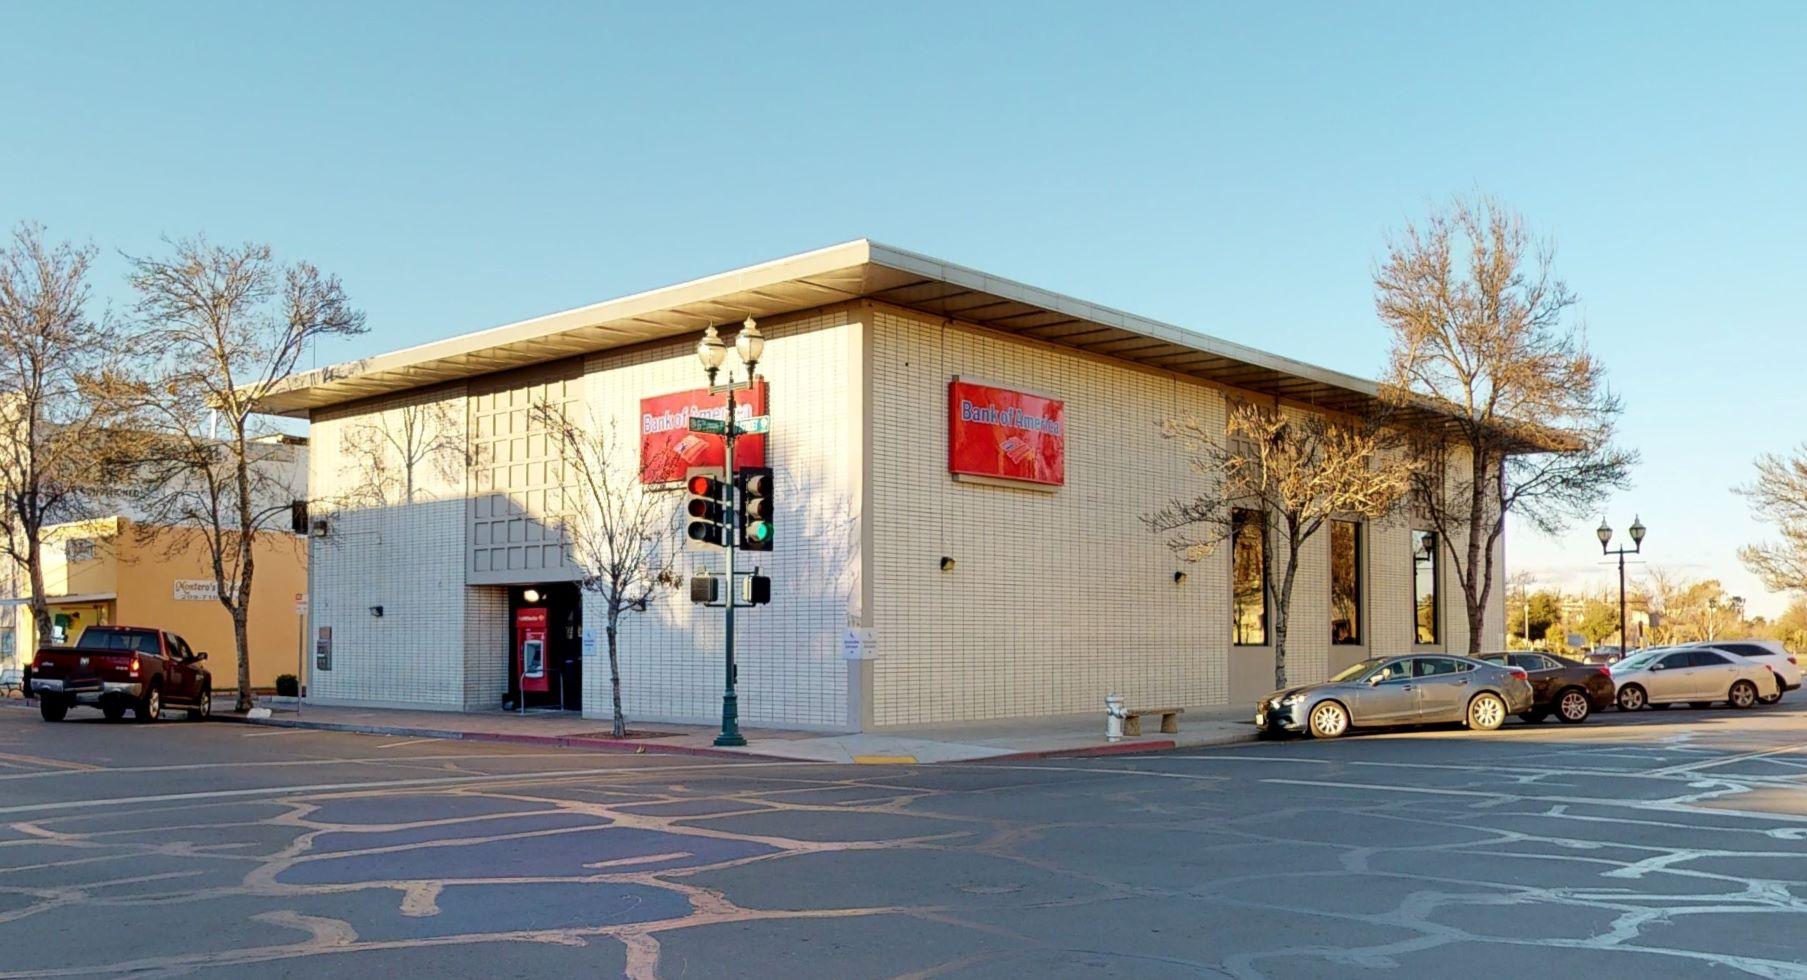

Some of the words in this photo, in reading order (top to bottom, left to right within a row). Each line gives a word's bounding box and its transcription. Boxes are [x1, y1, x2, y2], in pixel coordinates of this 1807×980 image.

[643, 409, 673, 434] Bank
[674, 405, 690, 428] of
[690, 403, 753, 421] Amerca
[962, 400, 998, 424] Bank
[1000, 409, 1014, 426] of
[1015, 408, 1060, 435] America
